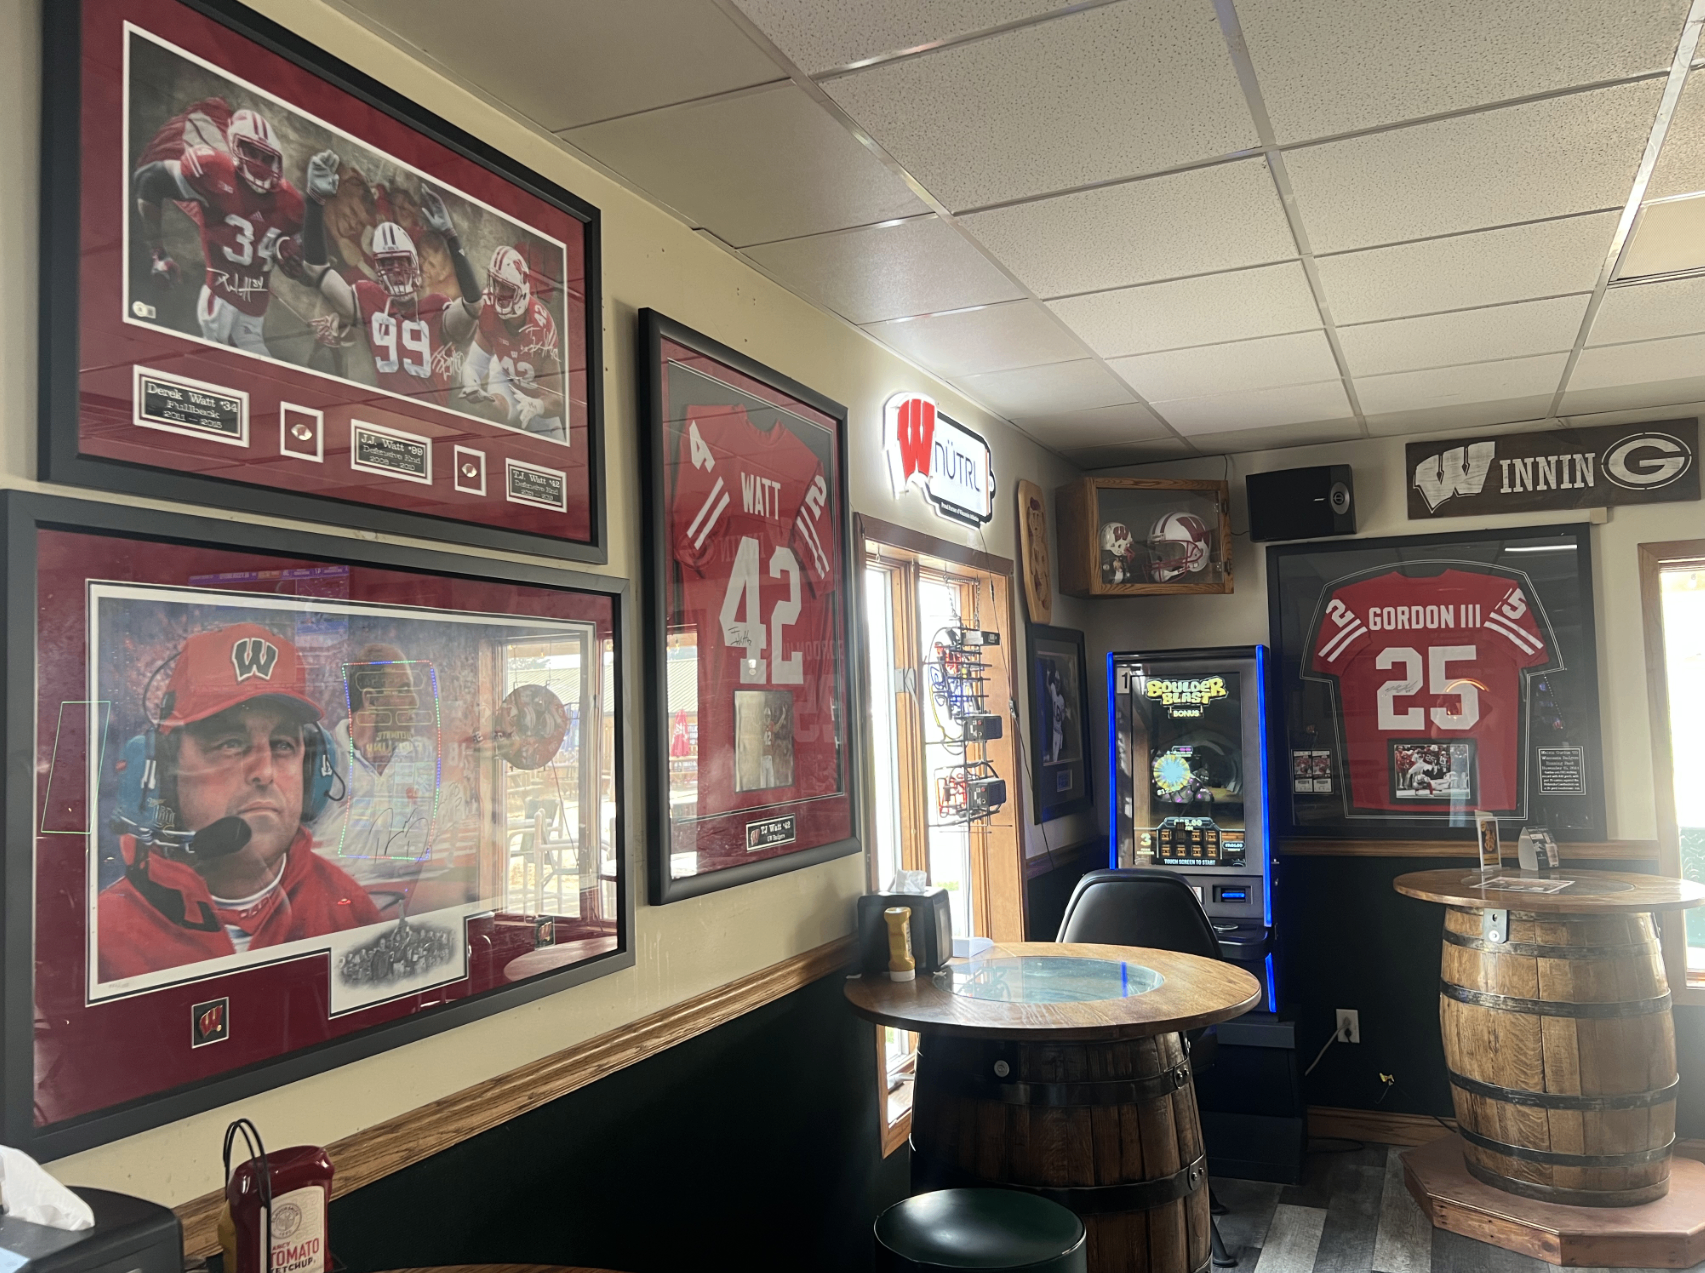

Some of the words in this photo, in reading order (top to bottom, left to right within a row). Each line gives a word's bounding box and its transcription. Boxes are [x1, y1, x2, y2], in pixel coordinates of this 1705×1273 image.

[371, 311, 432, 378] 99
[147, 382, 183, 400] Derek
[188, 392, 216, 408] Watt
[166, 400, 220, 419] Fullback
[381, 439, 405, 451] Watt
[529, 474, 547, 485] Watt
[741, 472, 782, 520] WATT
[719, 536, 804, 684] 42
[1368, 605, 1454, 631] GORDON
[1460, 604, 1481, 629] III
[1121, 672, 1128, 689] 1
[1146, 677, 1227, 697] BOULDER
[1376, 645, 1480, 730] 25
[1162, 692, 1211, 705] BLAST
[1173, 710, 1200, 718] BONUS
[1140, 833, 1152, 846] 3
[271, 1238, 320, 1268] TOMATO
[272, 1241, 292, 1250] ANCY
